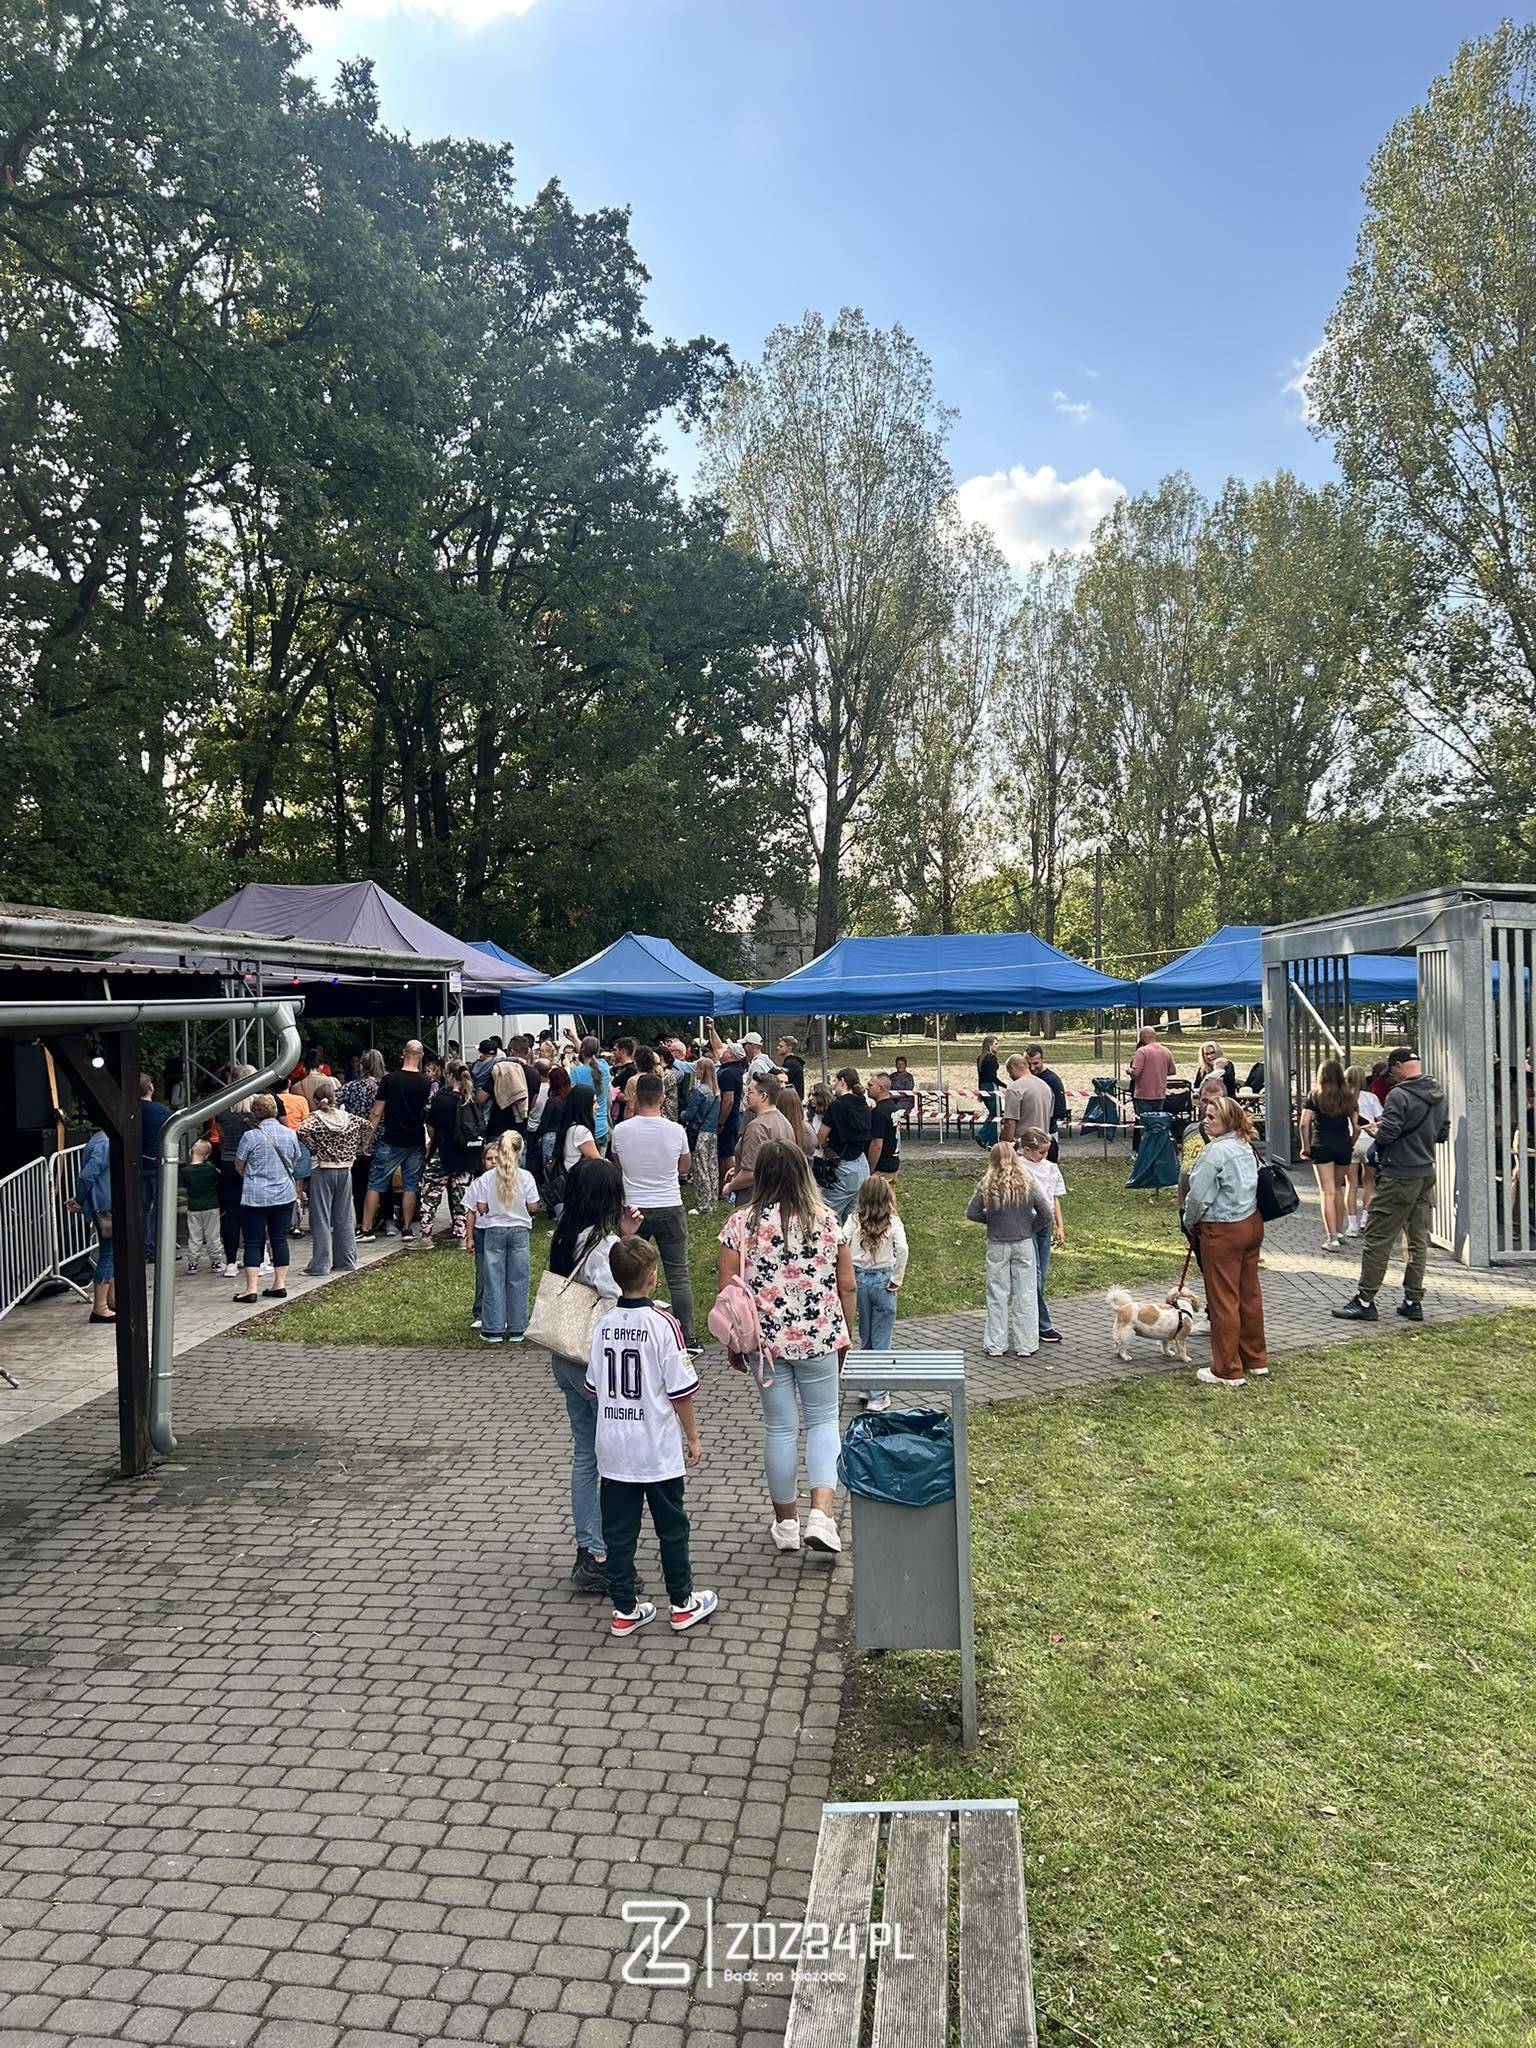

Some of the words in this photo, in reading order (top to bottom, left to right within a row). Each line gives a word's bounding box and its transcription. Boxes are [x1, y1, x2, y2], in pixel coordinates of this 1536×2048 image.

[601, 1328, 611, 1340] FC
[614, 1328, 648, 1342] BAYERN
[604, 1347, 642, 1400] 10
[604, 1406, 645, 1421] MUSIALA
